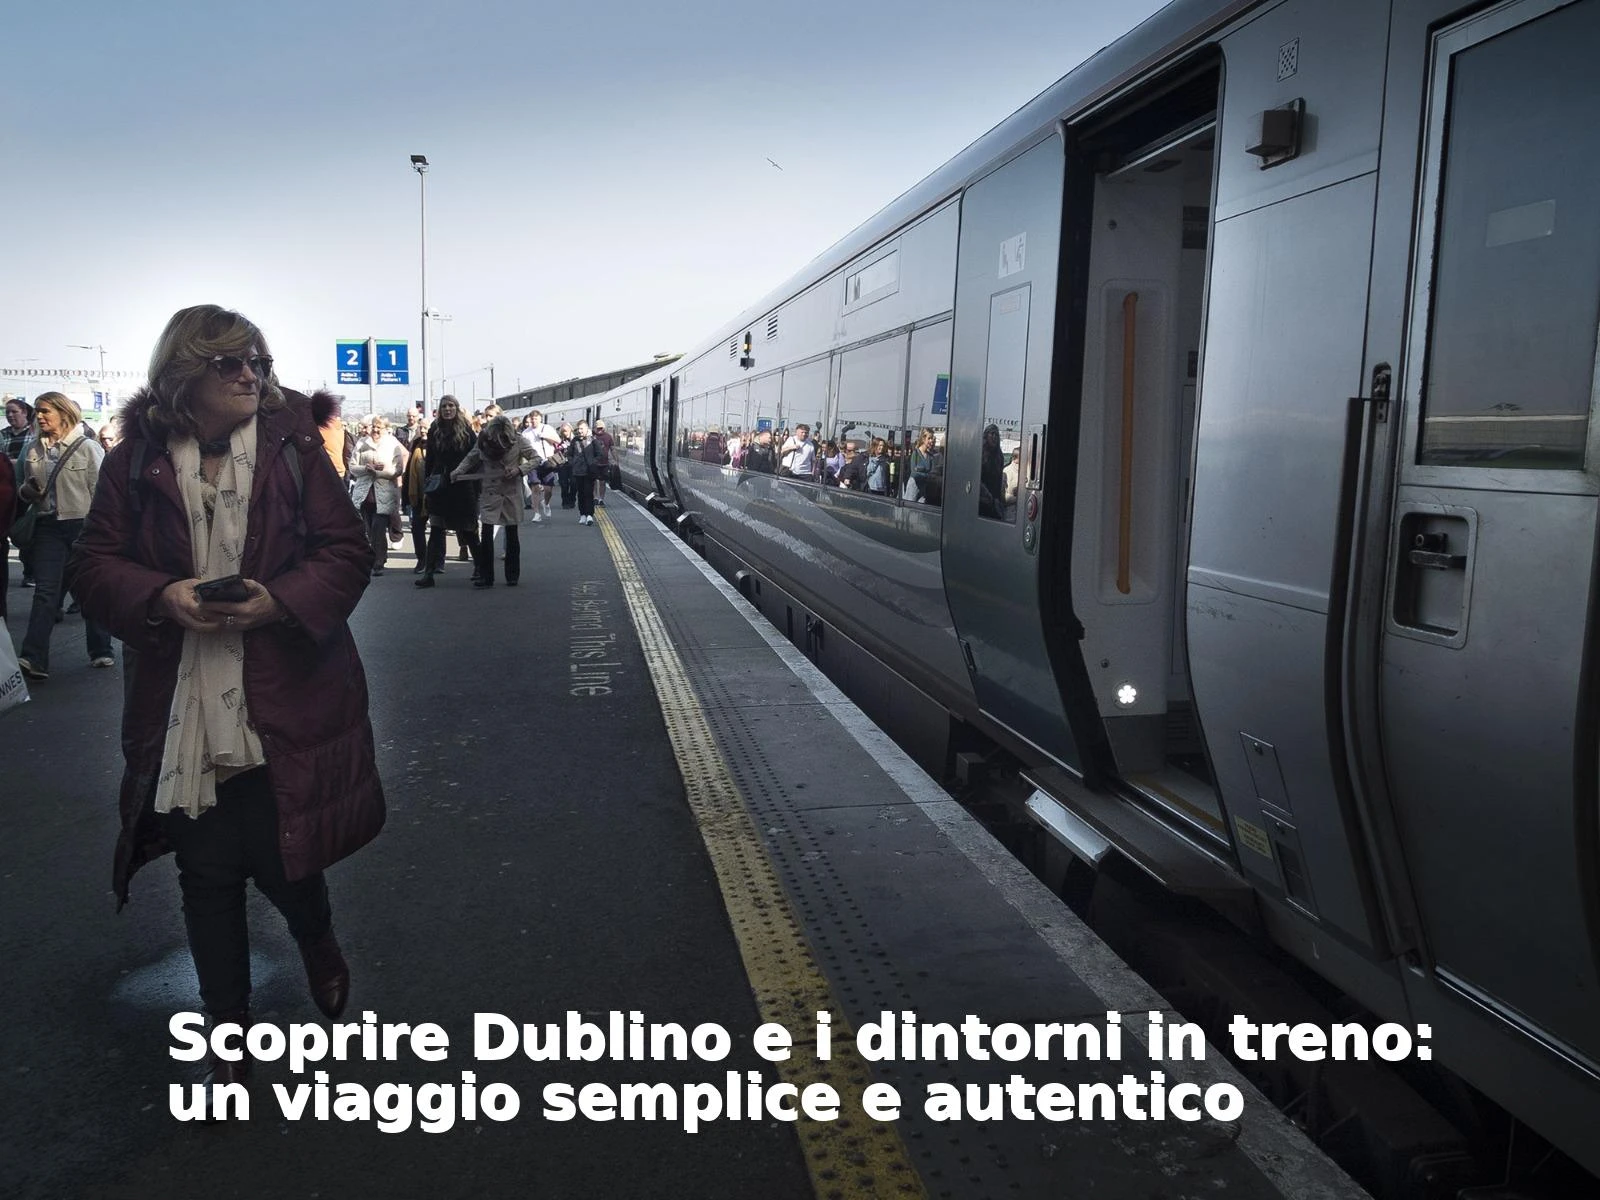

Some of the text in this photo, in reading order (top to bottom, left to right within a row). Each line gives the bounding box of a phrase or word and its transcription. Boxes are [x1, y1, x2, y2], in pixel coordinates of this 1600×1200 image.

[346, 349, 359, 366] 2
[388, 350, 397, 366] 1
[569, 599, 610, 630] Behind
[570, 632, 617, 659] This
[569, 662, 626, 697] Line
